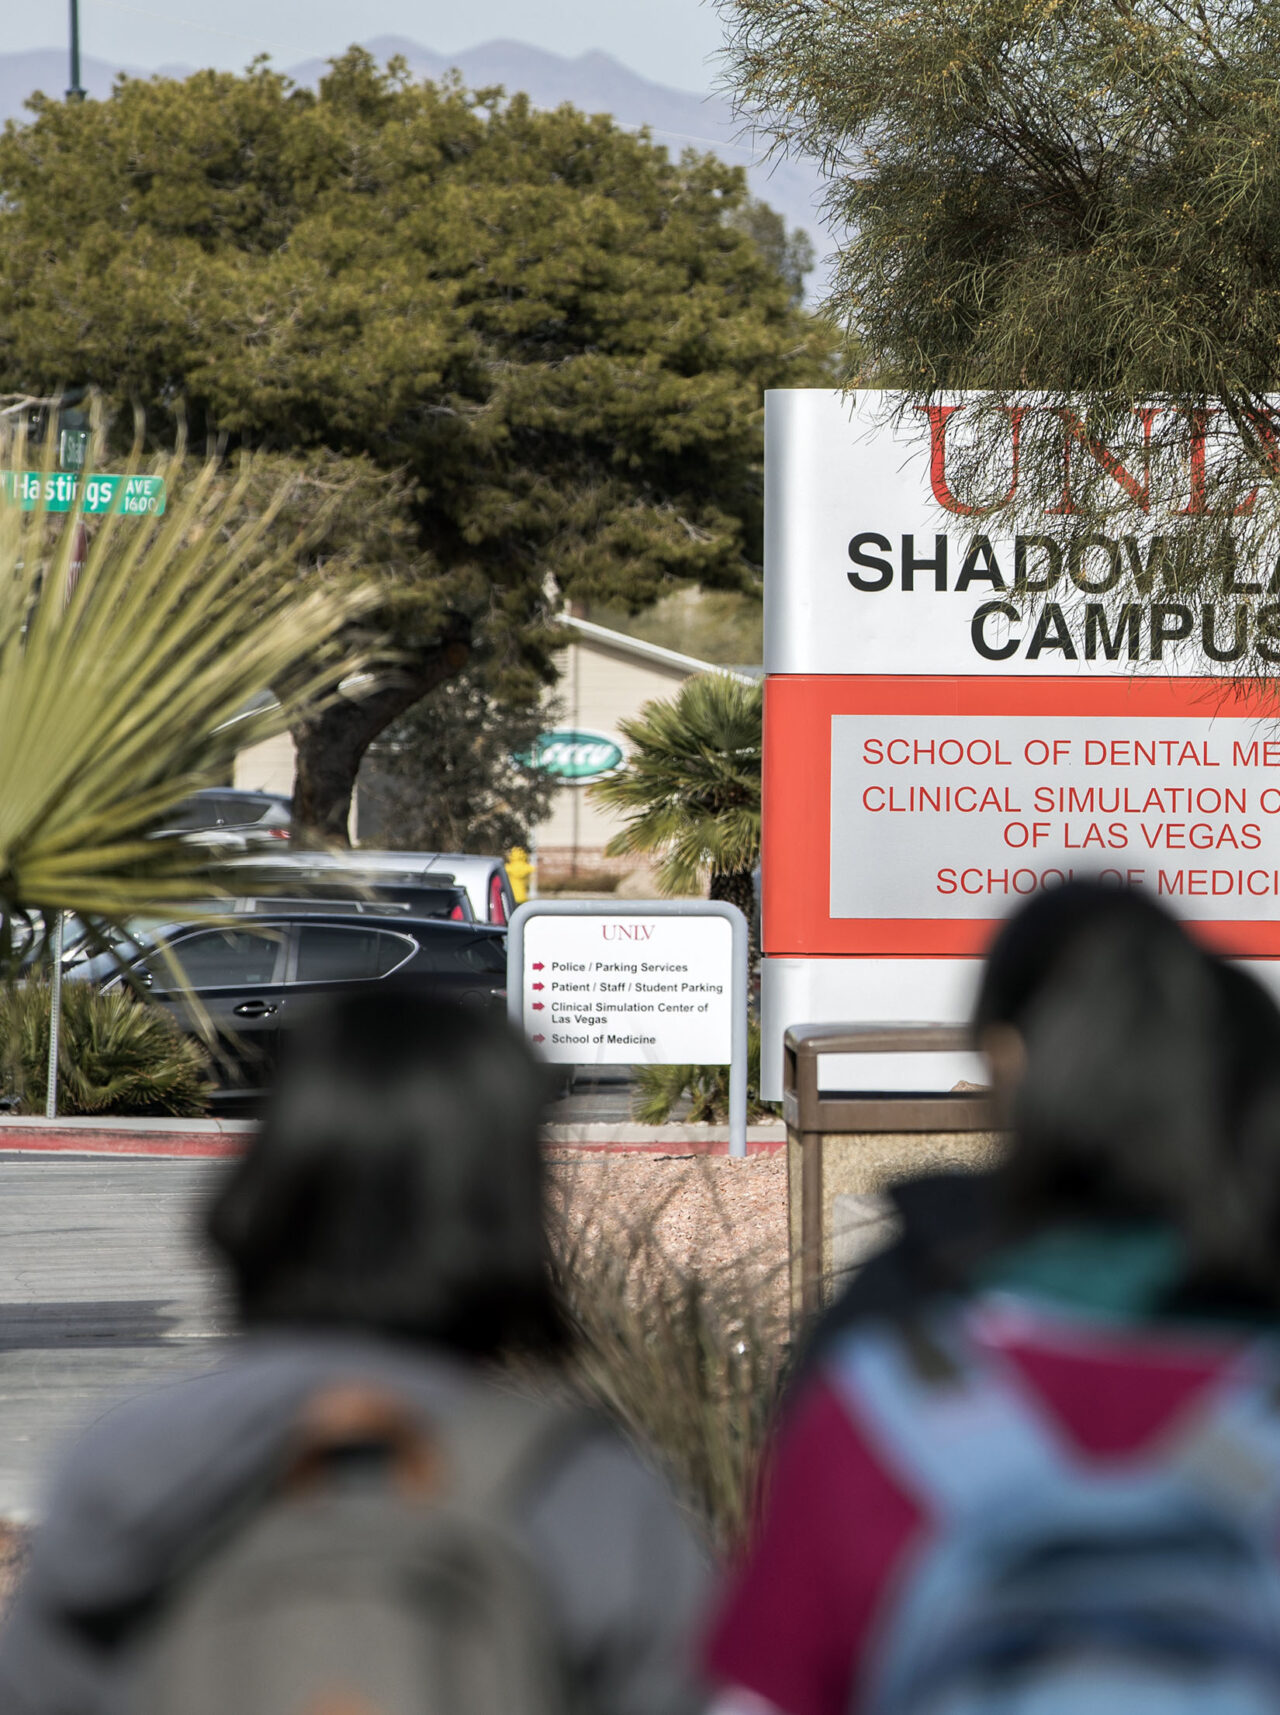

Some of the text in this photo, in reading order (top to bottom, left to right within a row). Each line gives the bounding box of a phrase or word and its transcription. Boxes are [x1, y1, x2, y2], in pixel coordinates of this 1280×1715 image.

[125, 479, 153, 496] AVE
[124, 495, 159, 513] 1600
[847, 532, 1199, 594] SHADOW
[862, 739, 1013, 766] SCHOOL
[1024, 739, 1072, 766] OF
[1085, 740, 1221, 767] DENTAL
[862, 785, 1022, 813] CLINICAL
[1034, 786, 1247, 814] SIMULATION
[1003, 821, 1262, 850] OF LAS VEGAS
[602, 924, 656, 941] UNLV
[551, 962, 586, 972] Police
[595, 962, 638, 974] Parking
[640, 962, 688, 972] Services
[551, 982, 590, 992] Patient
[599, 982, 626, 992] Staff
[635, 983, 678, 992] Student
[681, 983, 723, 994] Parking
[551, 1002, 709, 1013] Clinical Simulation Center of
[551, 1014, 608, 1026] Las Vegas
[551, 1034, 656, 1044] School of Medicine
